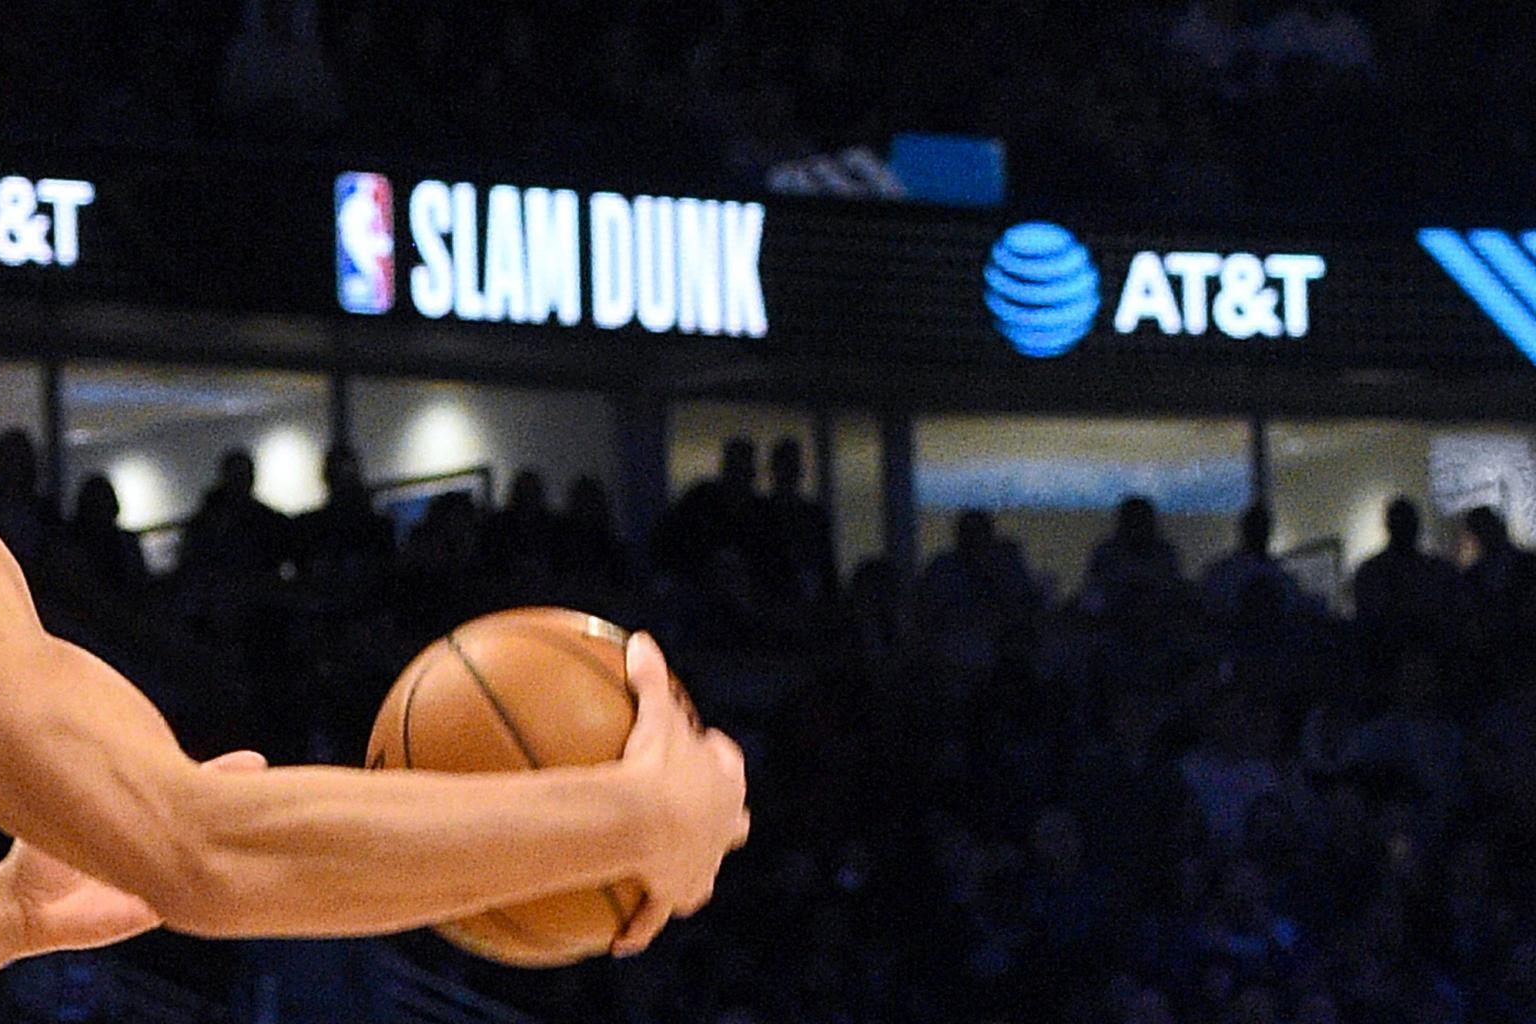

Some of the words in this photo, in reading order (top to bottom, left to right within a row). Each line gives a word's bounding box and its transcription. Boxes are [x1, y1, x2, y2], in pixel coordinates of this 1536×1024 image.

[409, 180, 580, 324] SLAM
[589, 192, 767, 337] DUNK
[1114, 251, 1325, 337] AT&T
